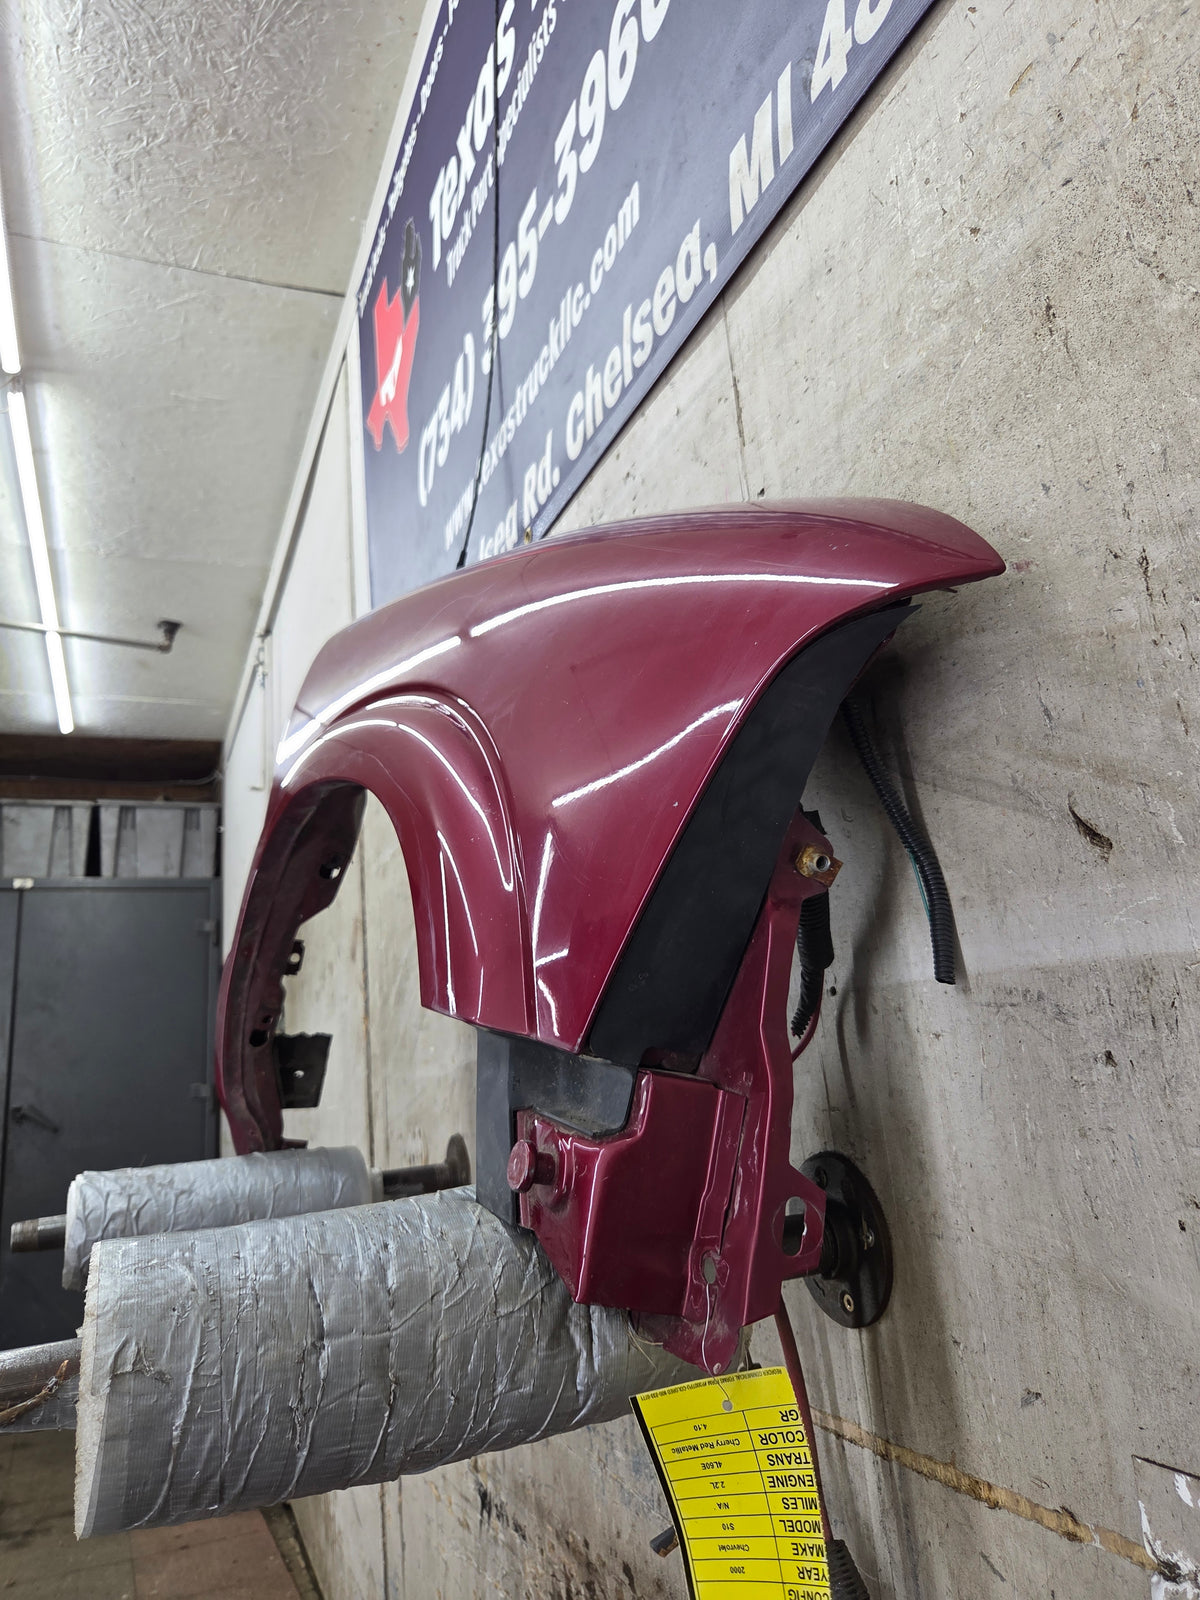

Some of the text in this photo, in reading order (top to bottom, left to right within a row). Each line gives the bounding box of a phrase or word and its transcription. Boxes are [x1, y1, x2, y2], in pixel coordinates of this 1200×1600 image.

[429, 0, 515, 272] Texas
[446, 208, 472, 288] Truck
[471, 152, 495, 230] Part
[523, 430, 560, 529] Rd.
[565, 218, 718, 461] Chelsea,
[729, 61, 793, 236] MI
[445, 181, 639, 551] wwwtexastruckllc.com
[418, 332, 475, 507] (734)
[693, 1408, 799, 1432] GR 4.10
[671, 1430, 805, 1454] COLOR Cherry Red Metallic
[700, 1451, 811, 1470] TRANS 4L60E
[709, 1474, 814, 1490] ENGINE 2.2L
[716, 1497, 818, 1510] MILES N/A
[722, 1519, 821, 1533] MODEL S10
[718, 1542, 825, 1557] MAKE Chevrolet
[729, 1566, 828, 1582] YEAR 2000
